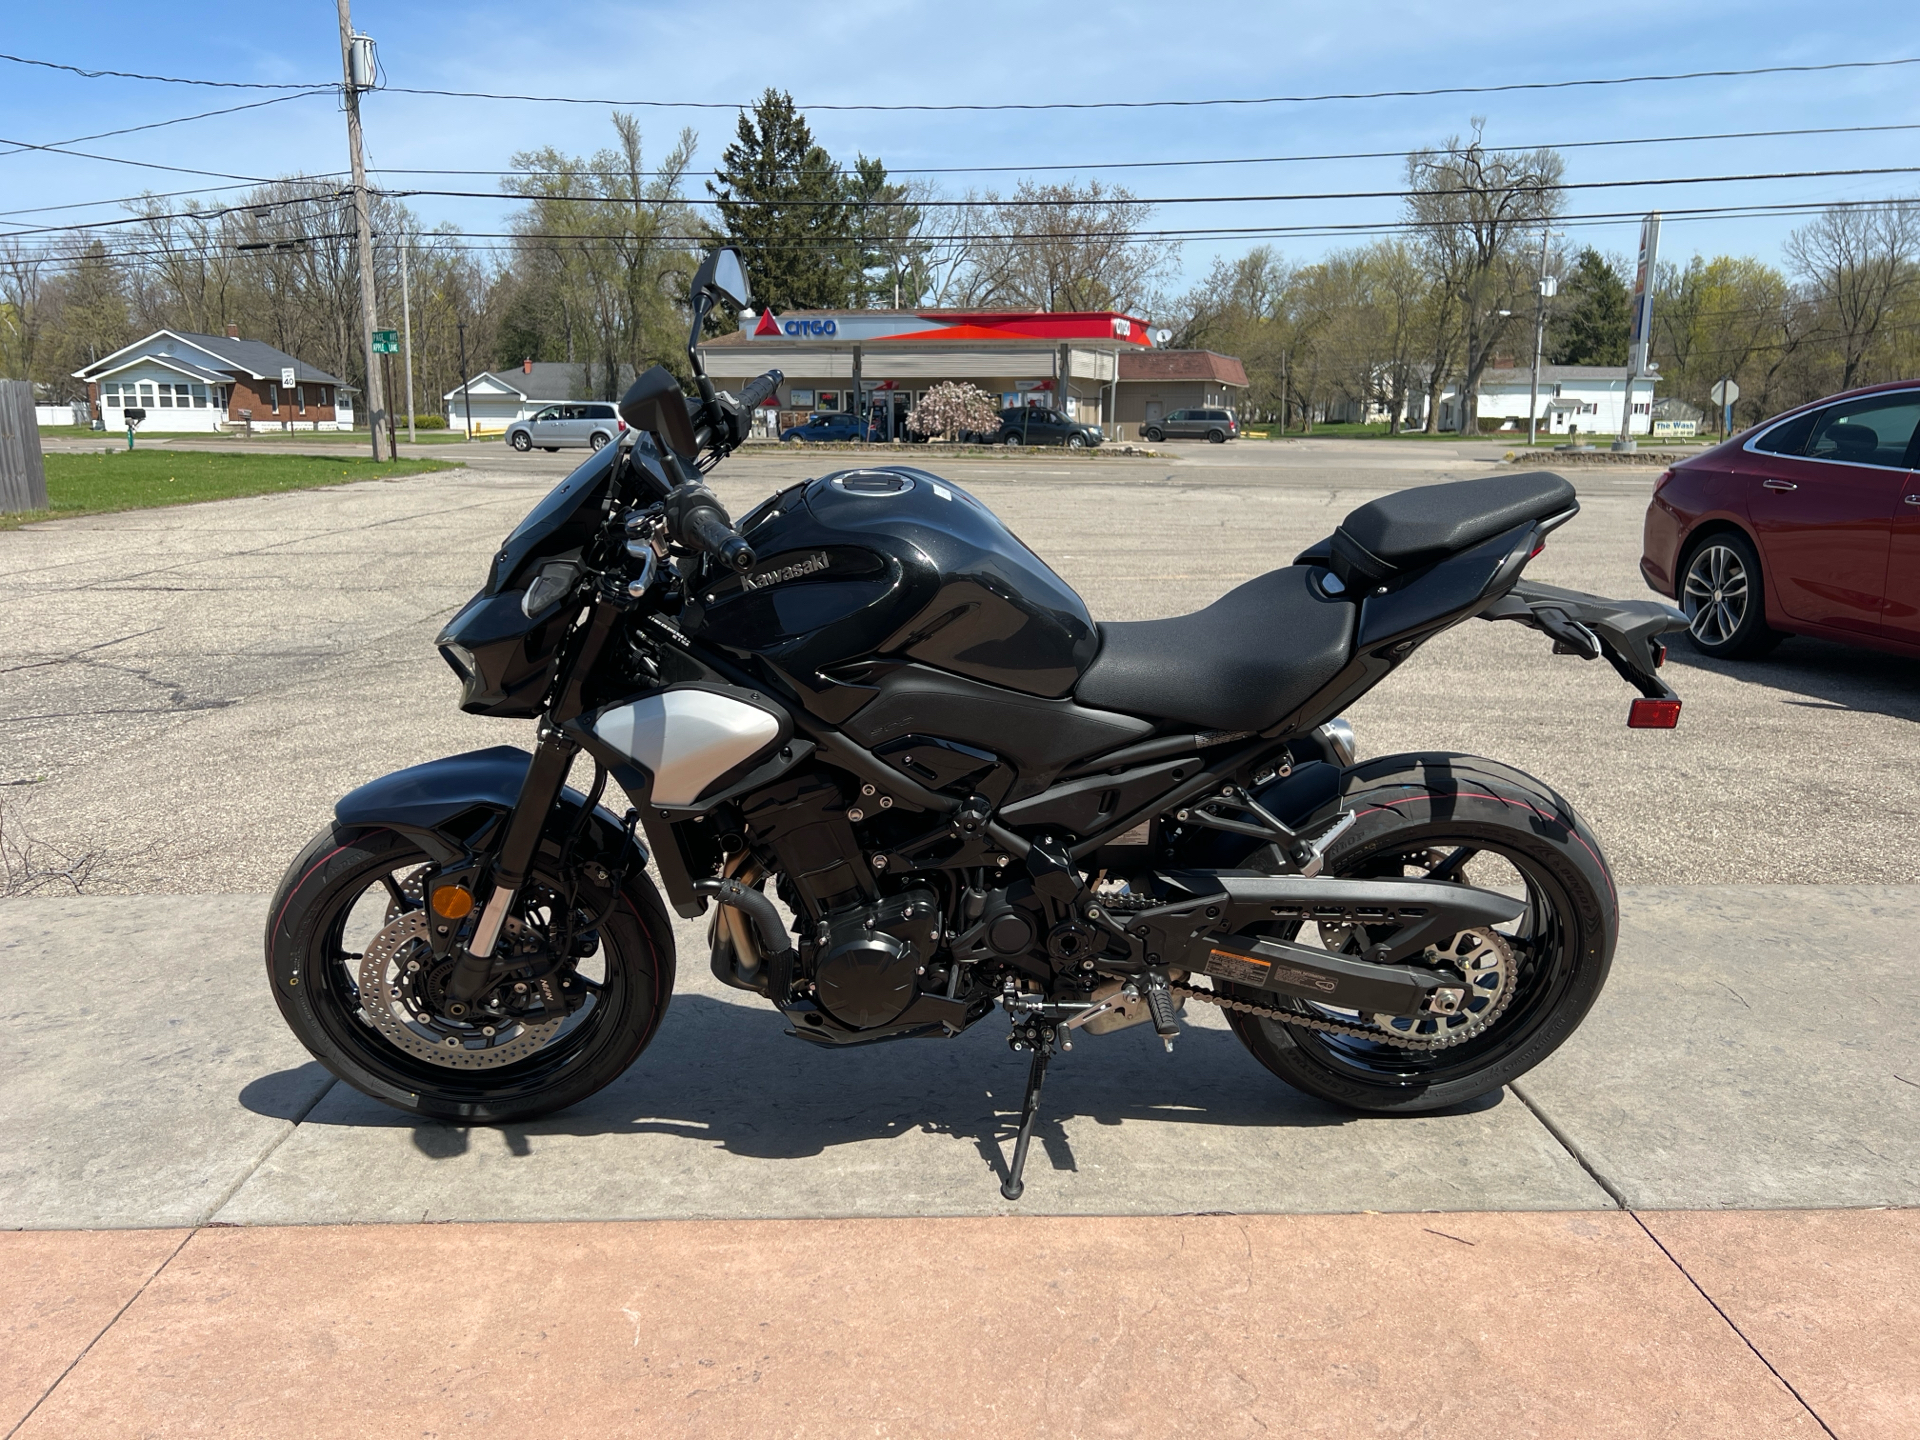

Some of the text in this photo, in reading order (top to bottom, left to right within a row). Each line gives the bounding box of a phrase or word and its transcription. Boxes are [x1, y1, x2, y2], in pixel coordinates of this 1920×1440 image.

[784, 320, 836, 335] CITGO
[372, 332, 398, 342] PAGE AVE
[372, 343, 398, 352] APPLE LANE
[283, 378, 294, 386] 40
[1656, 421, 1694, 430] The Wash
[740, 551, 830, 592] Kawasaki
[1560, 868, 1592, 914] DUNLOP
